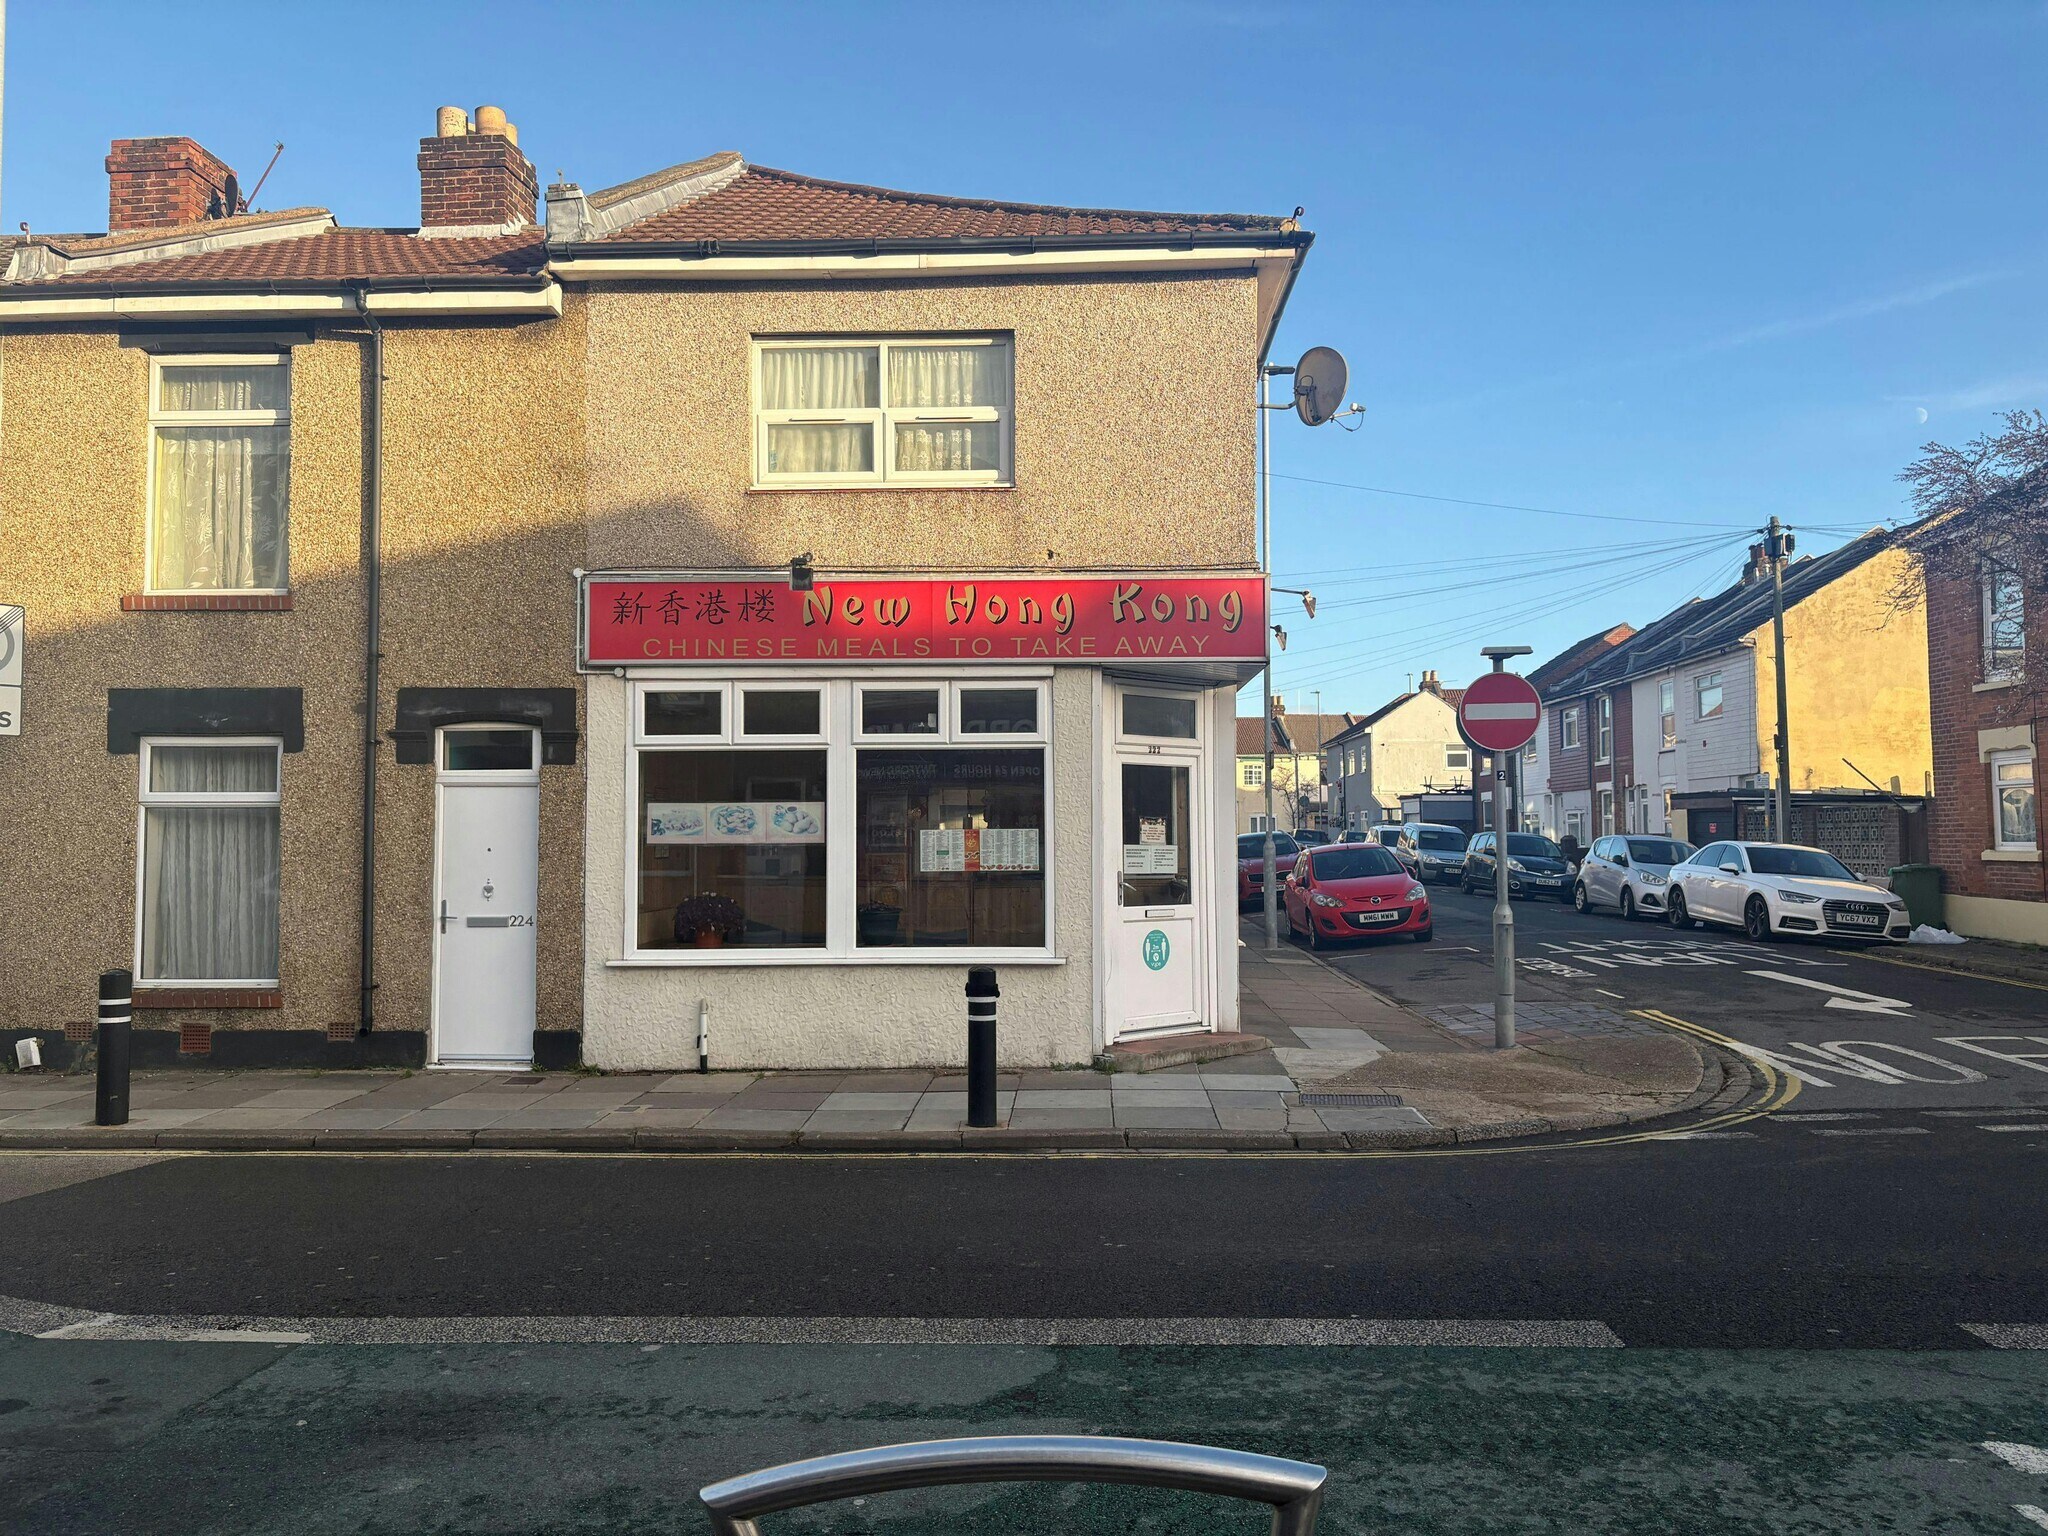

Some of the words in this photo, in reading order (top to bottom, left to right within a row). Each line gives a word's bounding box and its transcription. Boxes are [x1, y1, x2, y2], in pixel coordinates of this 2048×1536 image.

[611, 588, 775, 626] 新香港楼
[803, 586, 911, 627] New
[945, 584, 1075, 635] Hong
[1109, 582, 1244, 633] Kong
[643, 638, 797, 657] CHINESE
[817, 637, 931, 656] MEALS
[949, 637, 991, 655] TO
[1010, 636, 1096, 655] TAKE
[1114, 635, 1209, 654] AWAY
[1148, 746, 1161, 754] 222
[1499, 772, 1505, 780] 2
[509, 915, 534, 927] 224
[1840, 914, 1859, 922] YC67
[1860, 915, 1876, 923] VXZ
[1538, 939, 1777, 954] RIGHT
[1573, 951, 1848, 968] TURN
[1734, 1040, 1988, 1088] NO
